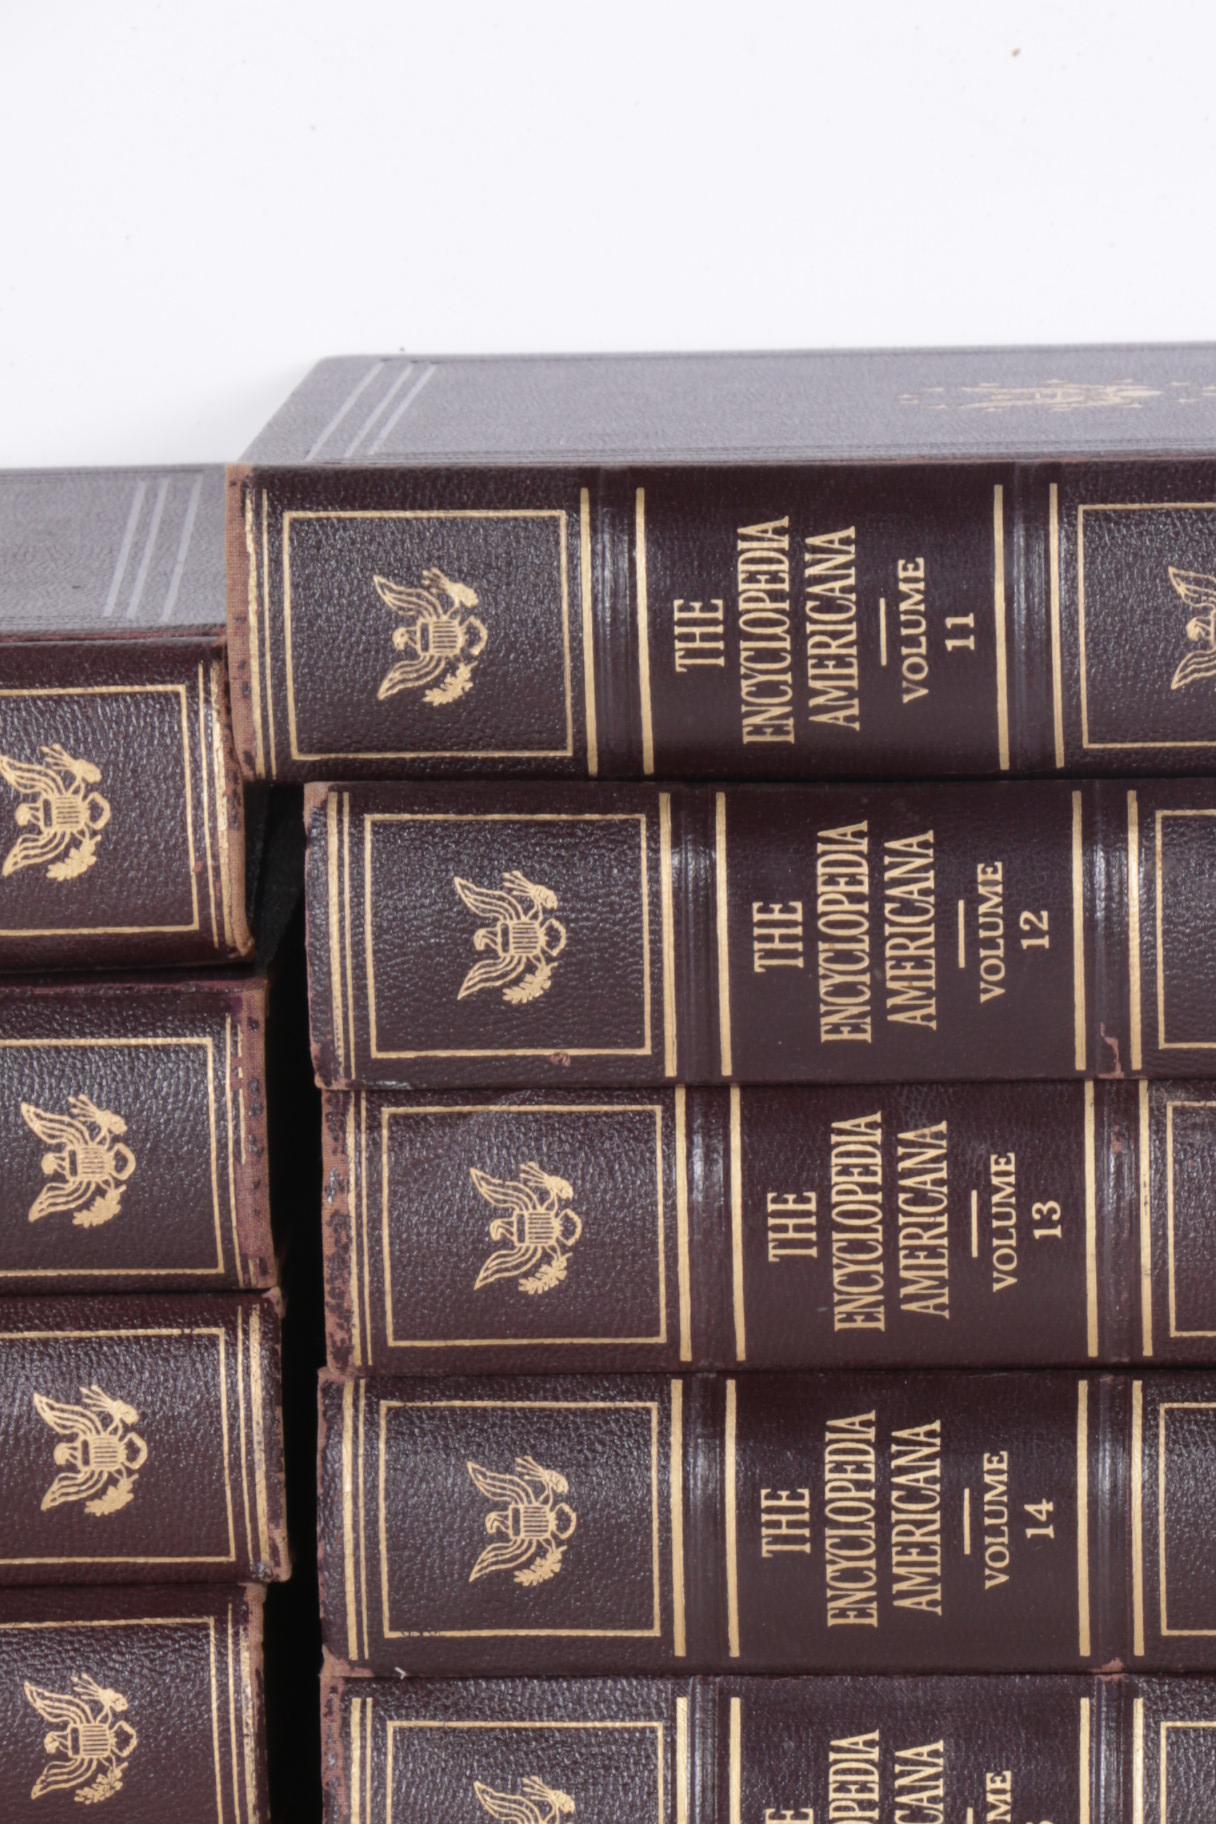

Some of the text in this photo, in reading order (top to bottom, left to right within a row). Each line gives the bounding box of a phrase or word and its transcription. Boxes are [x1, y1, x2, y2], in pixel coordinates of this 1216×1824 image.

[674, 599, 725, 672] THE
[737, 515, 794, 744] ENCYCLOPEDIA
[804, 526, 859, 731] AMERICANA
[898, 557, 929, 703] VOLUME
[945, 613, 976, 652] 11
[753, 900, 804, 973] THE
[816, 820, 872, 1043] ENCYCLOPEDIA
[884, 830, 937, 1030] AMERICANA
[977, 861, 1005, 1003] VOLUME
[1019, 910, 1050, 950] 12
[768, 1191, 818, 1262] THE
[830, 1110, 886, 1332] ENCYCLOPEDIA
[897, 1119, 949, 1320] AMERICANA
[991, 1152, 1017, 1292] VOLUME
[1031, 1200, 1062, 1240] 13
[761, 1488, 811, 1558] THE
[825, 1410, 879, 1627] ENCYCLOPEDIA
[892, 1420, 942, 1615] AMERICANA
[983, 1451, 1011, 1590] VOLUME
[1024, 1499, 1056, 1538] 14
